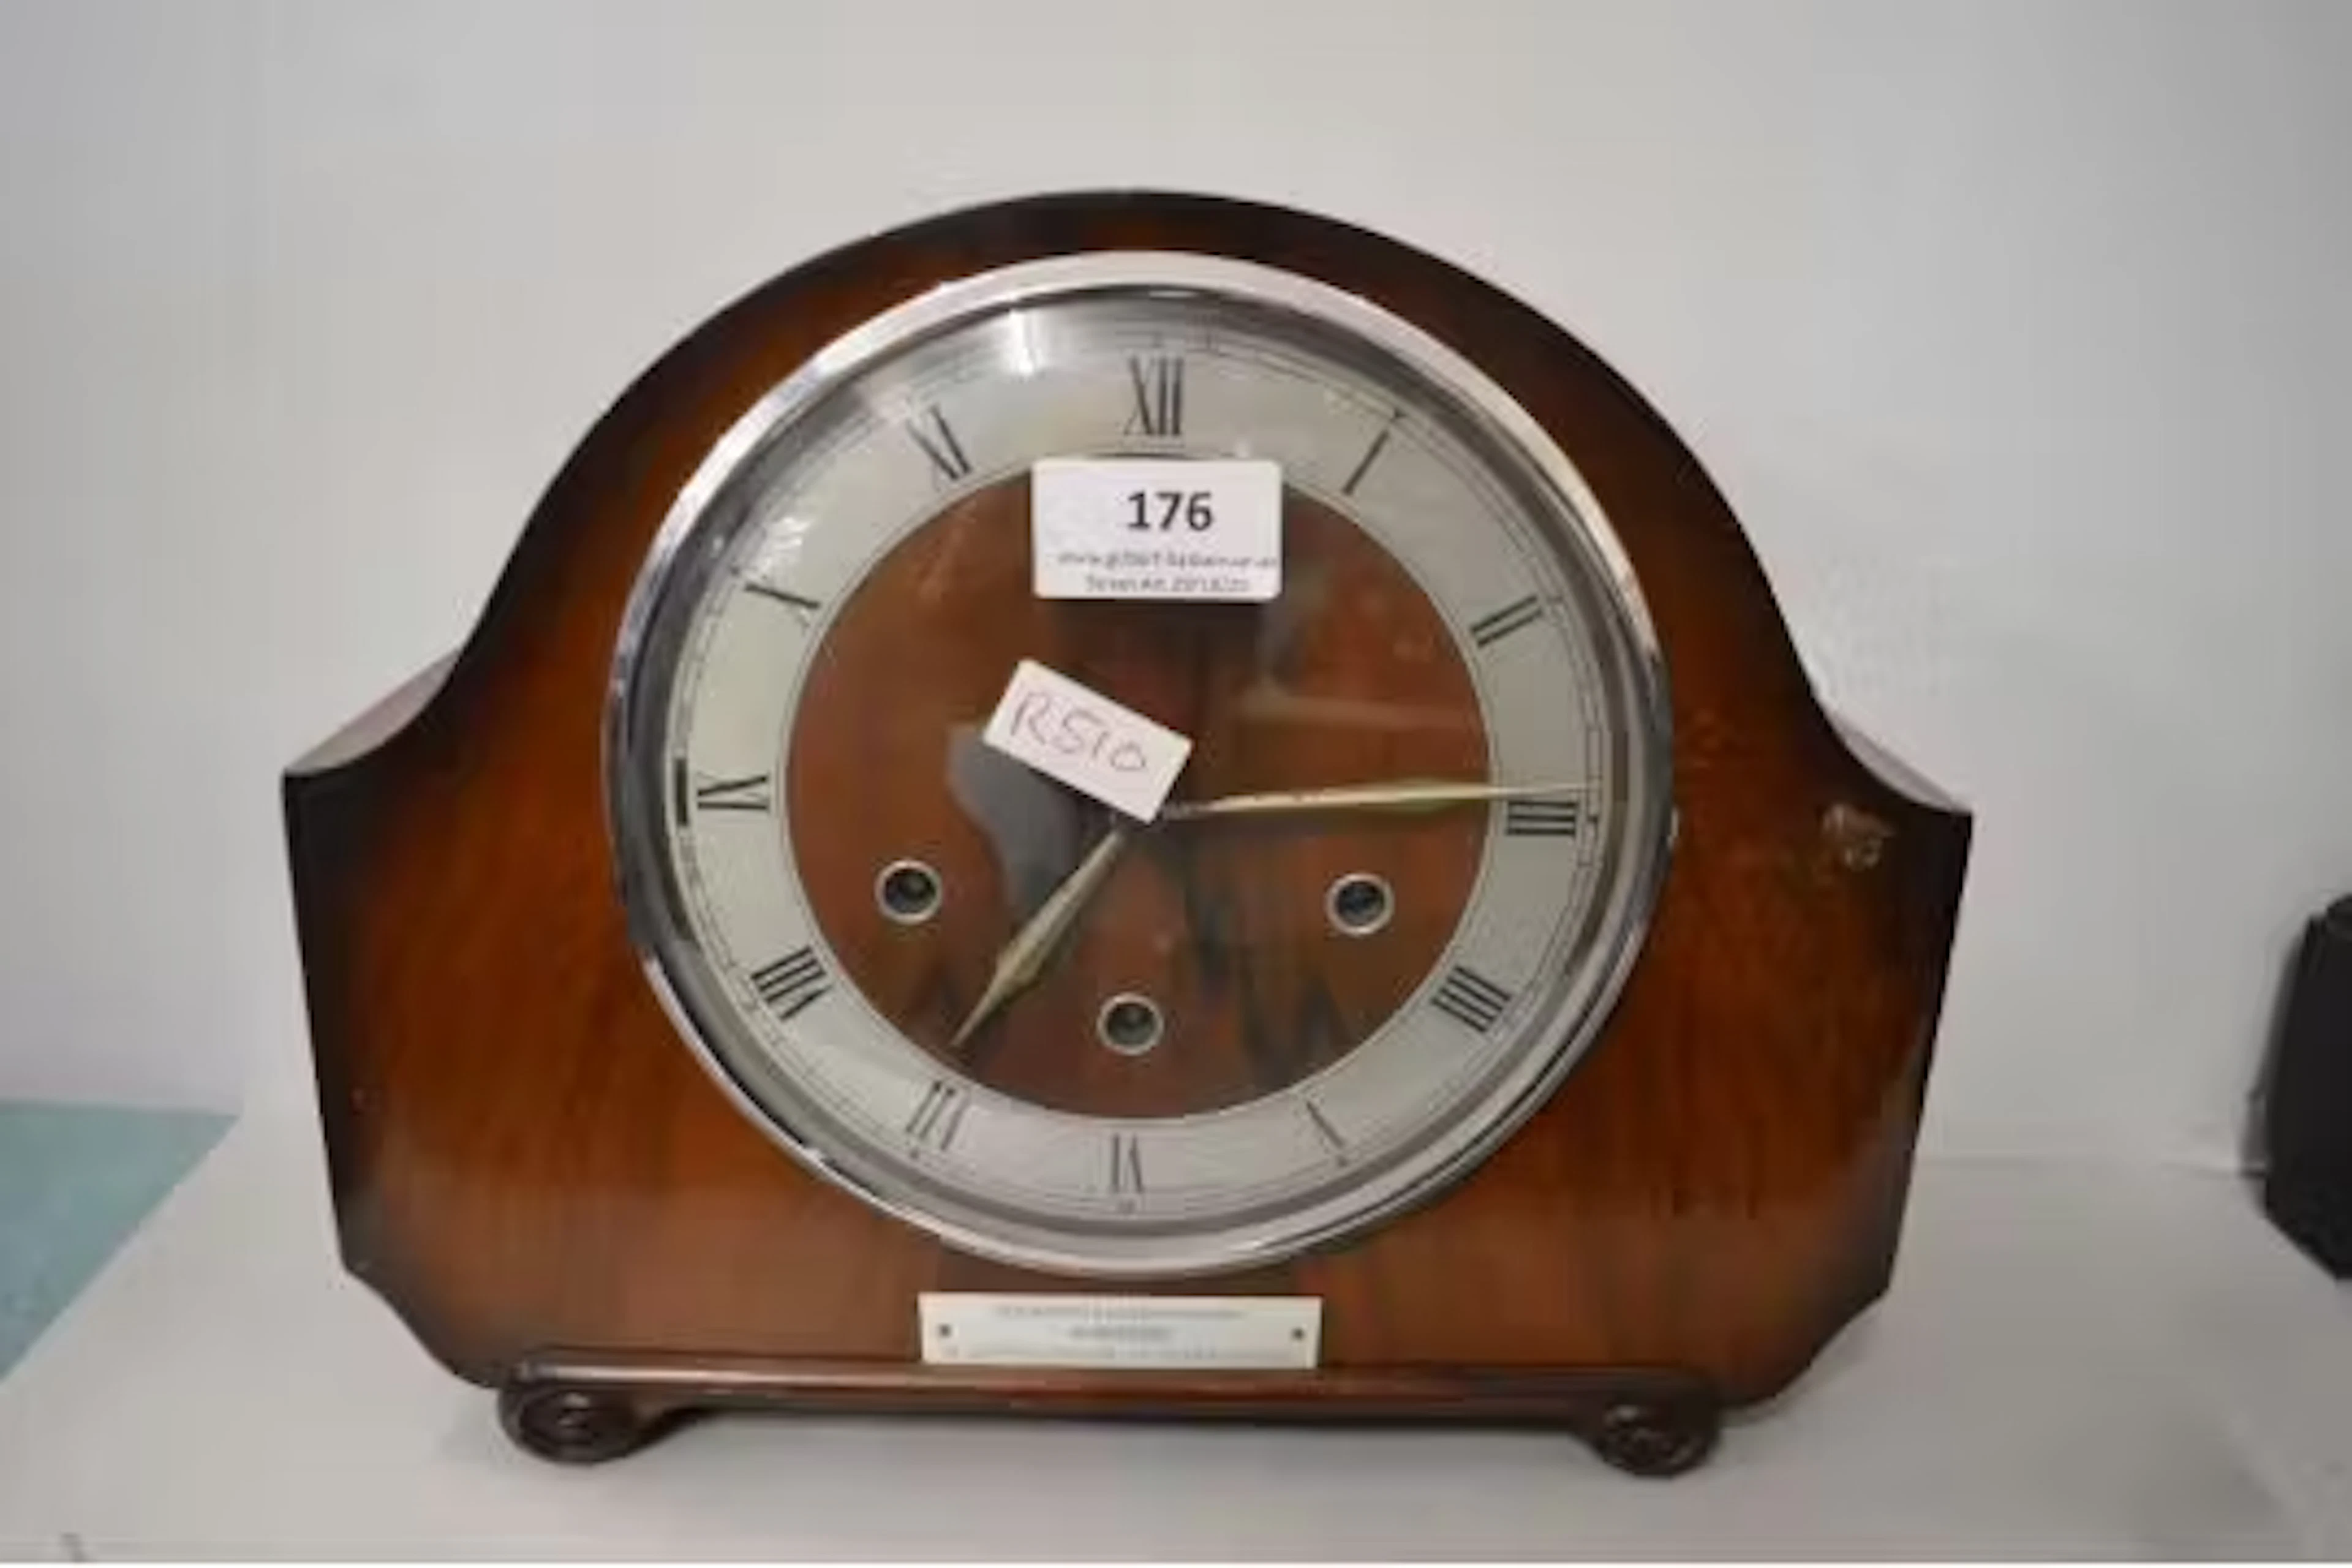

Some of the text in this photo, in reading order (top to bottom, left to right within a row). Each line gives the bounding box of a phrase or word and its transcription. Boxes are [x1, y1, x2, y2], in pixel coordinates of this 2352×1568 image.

[1123, 354, 1185, 437] XII
[1341, 428, 1392, 496] I
[1125, 489, 1214, 533] 176
[1470, 594, 1542, 649] II
[1504, 799, 1580, 837] III
